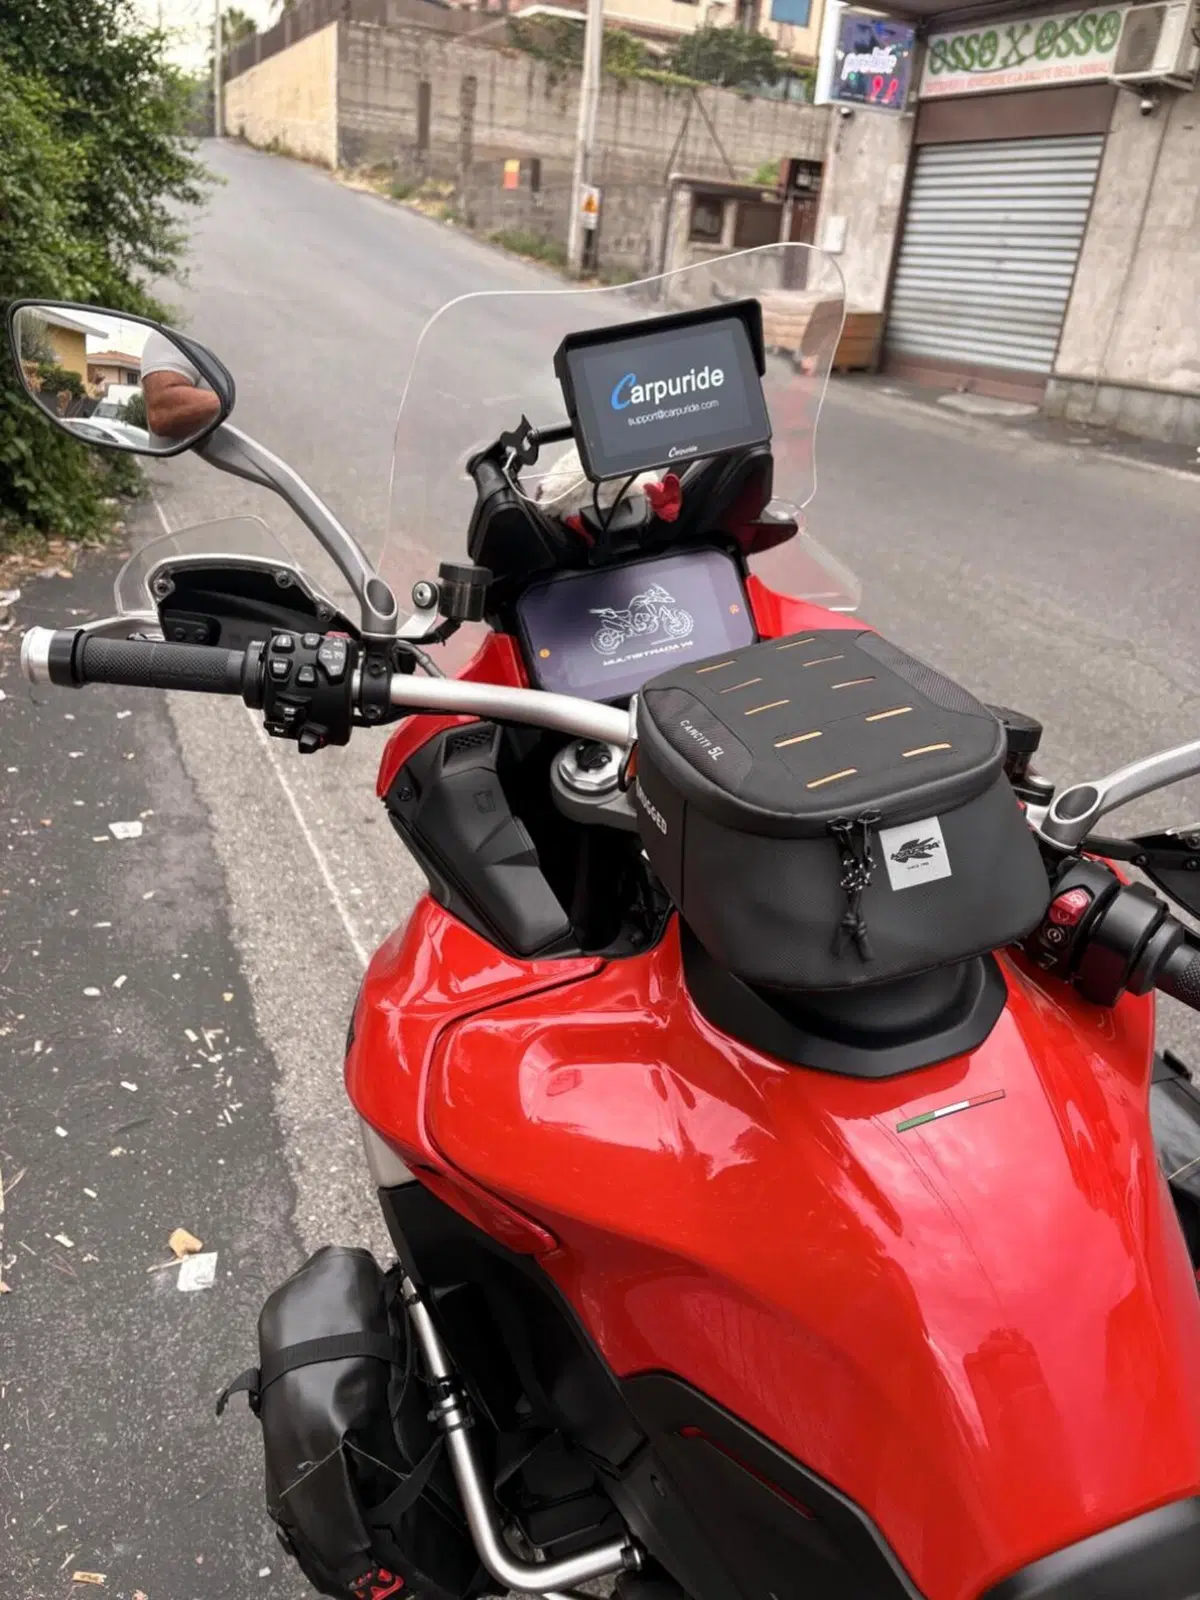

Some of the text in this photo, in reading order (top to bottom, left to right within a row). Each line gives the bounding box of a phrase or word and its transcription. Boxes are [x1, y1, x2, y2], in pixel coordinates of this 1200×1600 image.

[611, 365, 724, 410] Carpuride
[627, 400, 720, 426] support@carpuride.com
[707, 746, 724, 761] 5L
